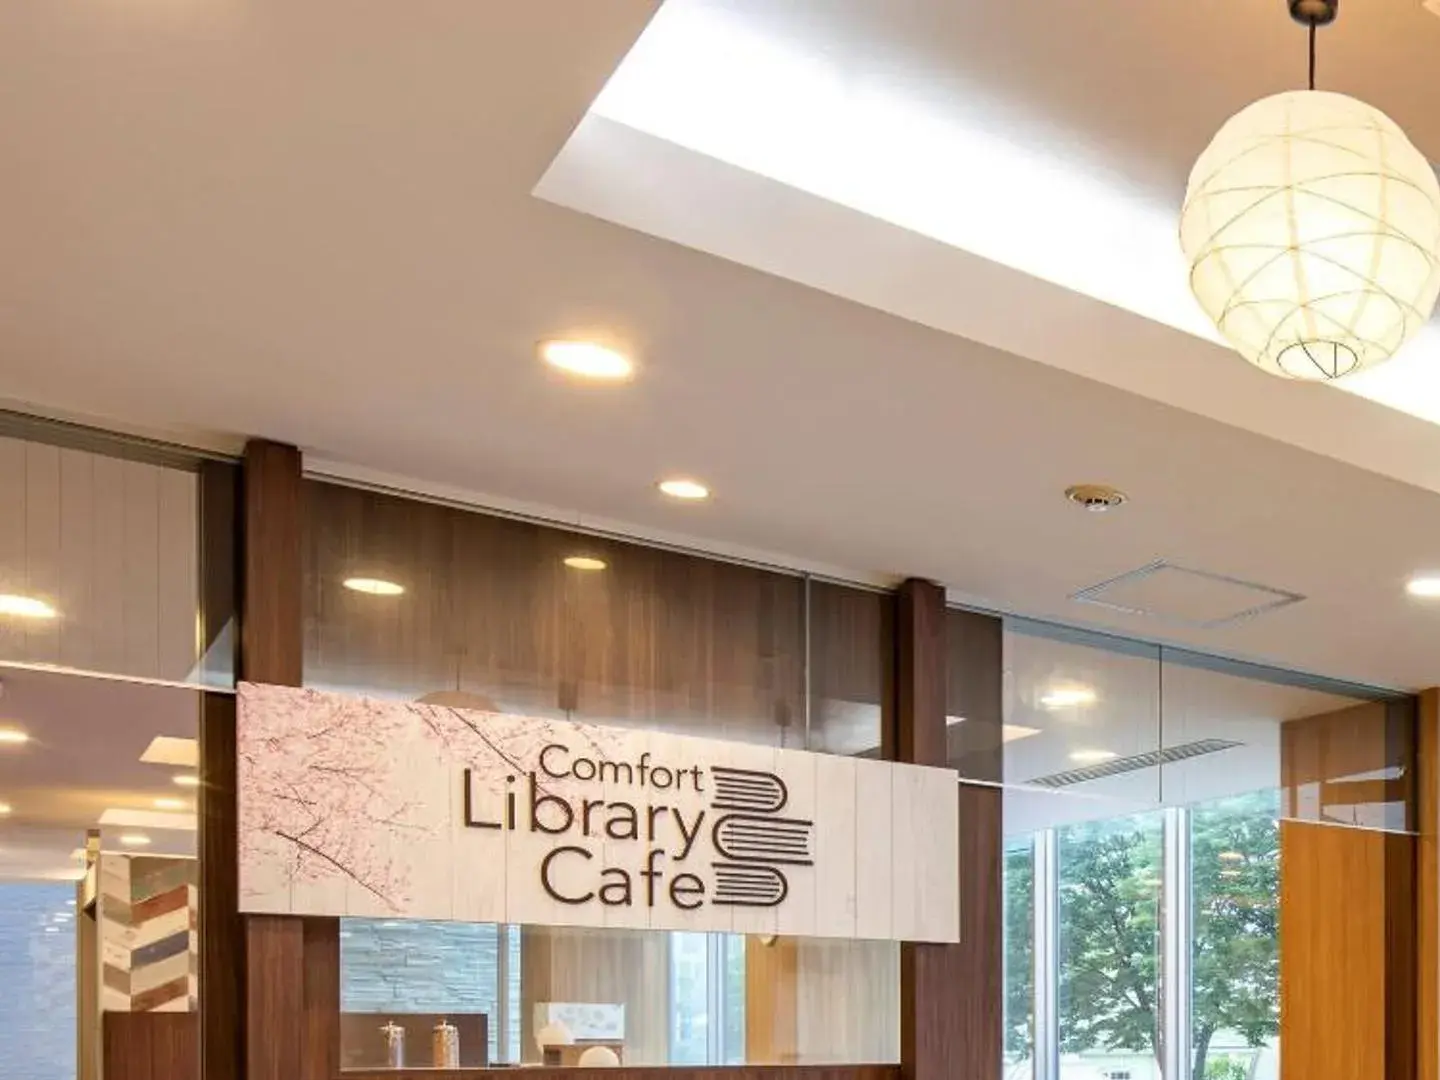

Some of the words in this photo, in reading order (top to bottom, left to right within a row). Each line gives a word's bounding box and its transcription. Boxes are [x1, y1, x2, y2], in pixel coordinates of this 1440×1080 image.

[539, 744, 704, 792] Comfort
[464, 768, 705, 861] Library
[541, 846, 705, 909] Cafe
